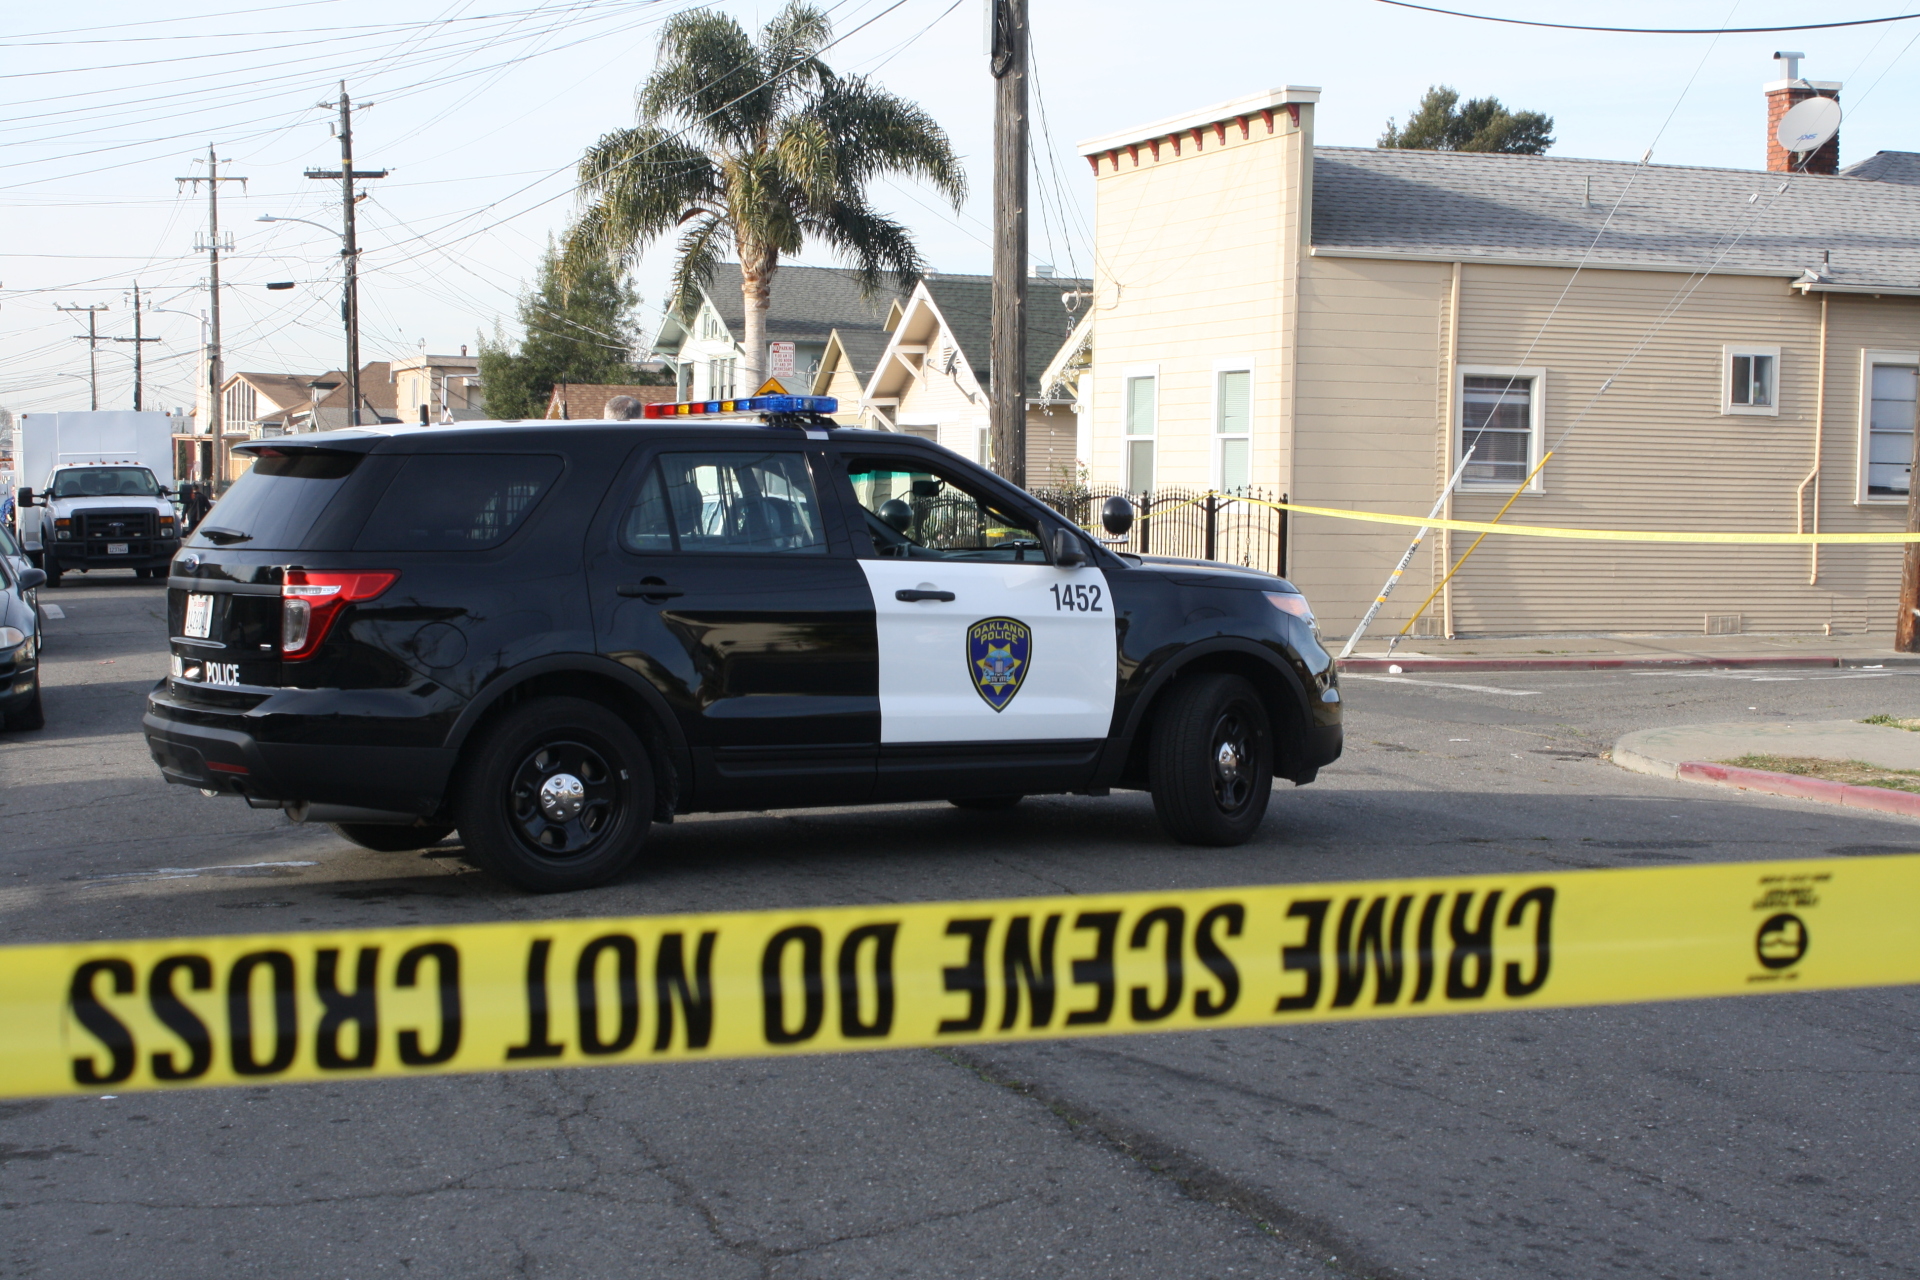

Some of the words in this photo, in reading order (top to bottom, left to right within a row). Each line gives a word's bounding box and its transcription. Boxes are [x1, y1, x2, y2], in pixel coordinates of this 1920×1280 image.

[974, 622, 1025, 639] OAKLAND
[980, 631, 1018, 645] POLICE
[1050, 583, 1103, 612] 1452
[205, 661, 240, 687] POLICE
[506, 932, 717, 1061] NOT
[761, 923, 899, 1047] DO
[938, 903, 1245, 1035] SCENE
[1276, 887, 1555, 1013] CRIME
[68, 942, 462, 1088] CROSS
